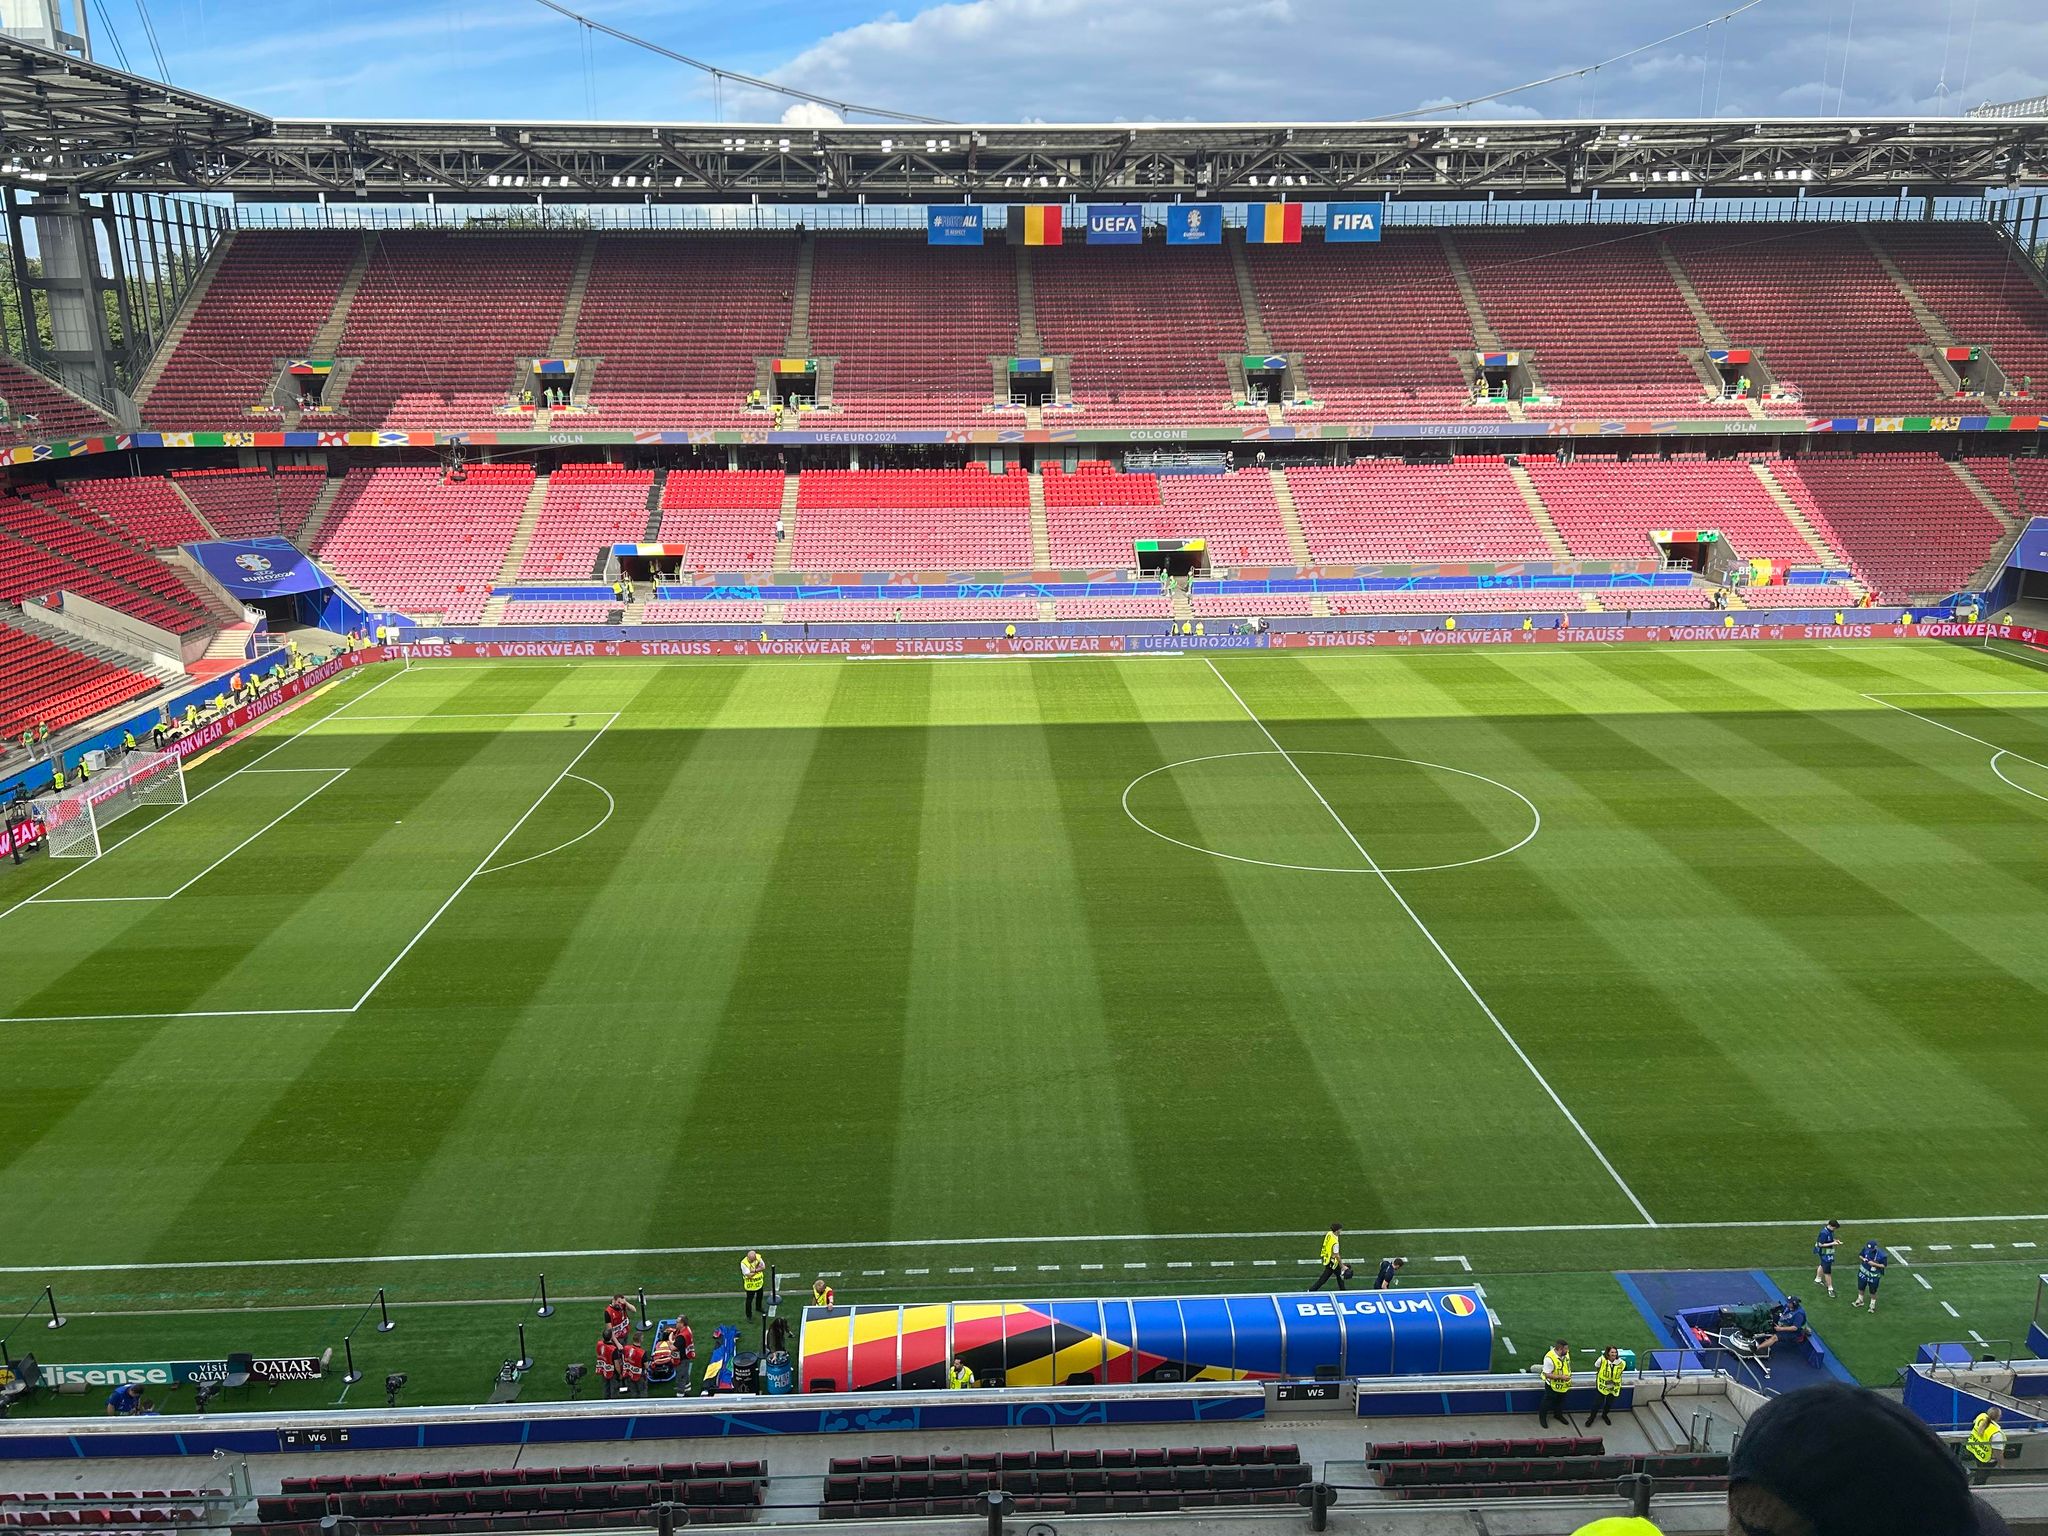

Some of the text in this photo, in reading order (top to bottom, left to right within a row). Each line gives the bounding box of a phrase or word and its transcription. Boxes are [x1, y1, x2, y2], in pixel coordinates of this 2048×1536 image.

[1092, 217, 1137, 232] UEFA
[1333, 214, 1374, 230] FIFA
[1725, 422, 1757, 432] KÖLN
[550, 432, 583, 443] KÖLN
[1130, 430, 1188, 439] COLOGNE
[1557, 629, 1625, 642] STRAUSS
[1669, 626, 1760, 640] WORKWEAR
[1804, 625, 1872, 638] STRAUSS
[1916, 623, 2011, 638] WORKWEAR
[1307, 634, 1376, 646] STRAUSS
[1421, 631, 1512, 644] WORKWEAR
[499, 643, 595, 657] WORKWEAR
[641, 642, 711, 655] STRAUSS
[758, 641, 850, 654] WORKWEAR
[895, 640, 963, 652] STRAUSS
[1008, 639, 1100, 651] WORKWEAR
[302, 658, 344, 689] WORKWEAR
[246, 691, 283, 720] STRAUSS
[1296, 1299, 1433, 1317] BELGIUM
[199, 1362, 229, 1372] visit
[252, 1360, 313, 1375] QATAR
[269, 1372, 314, 1380] AIRWAYS
[1307, 1389, 1325, 1397] W5
[308, 1433, 327, 1442] W6
